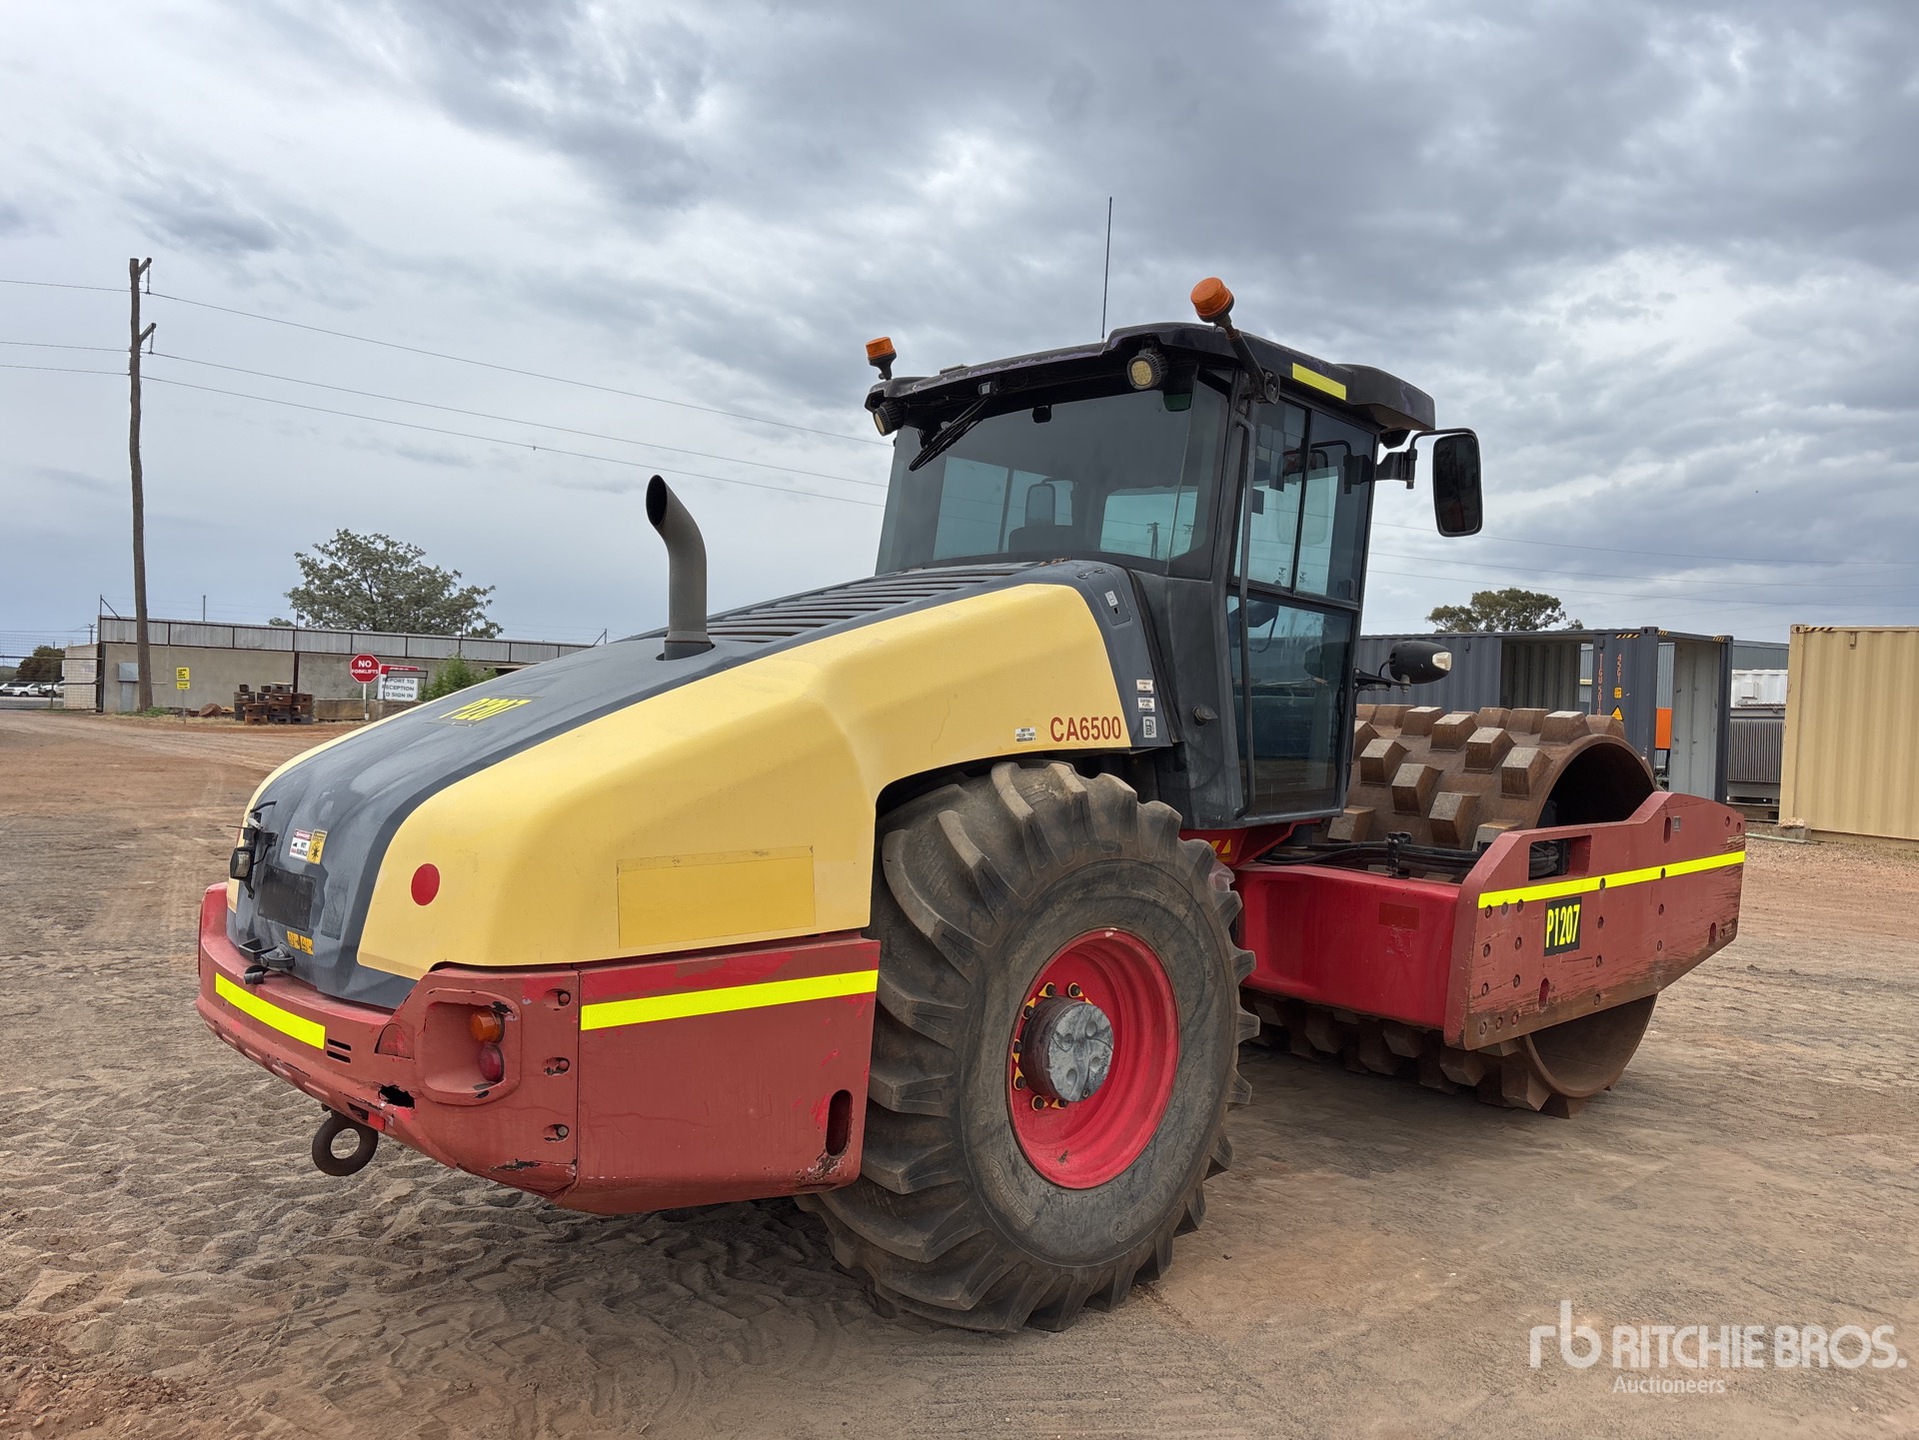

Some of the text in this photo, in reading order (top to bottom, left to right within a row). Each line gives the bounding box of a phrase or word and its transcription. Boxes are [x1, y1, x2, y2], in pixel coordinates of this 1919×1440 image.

[358, 660, 372, 668] NO
[438, 698, 532, 721] P1207
[1050, 715, 1121, 742] CA6500
[1546, 904, 1580, 948] P1207
